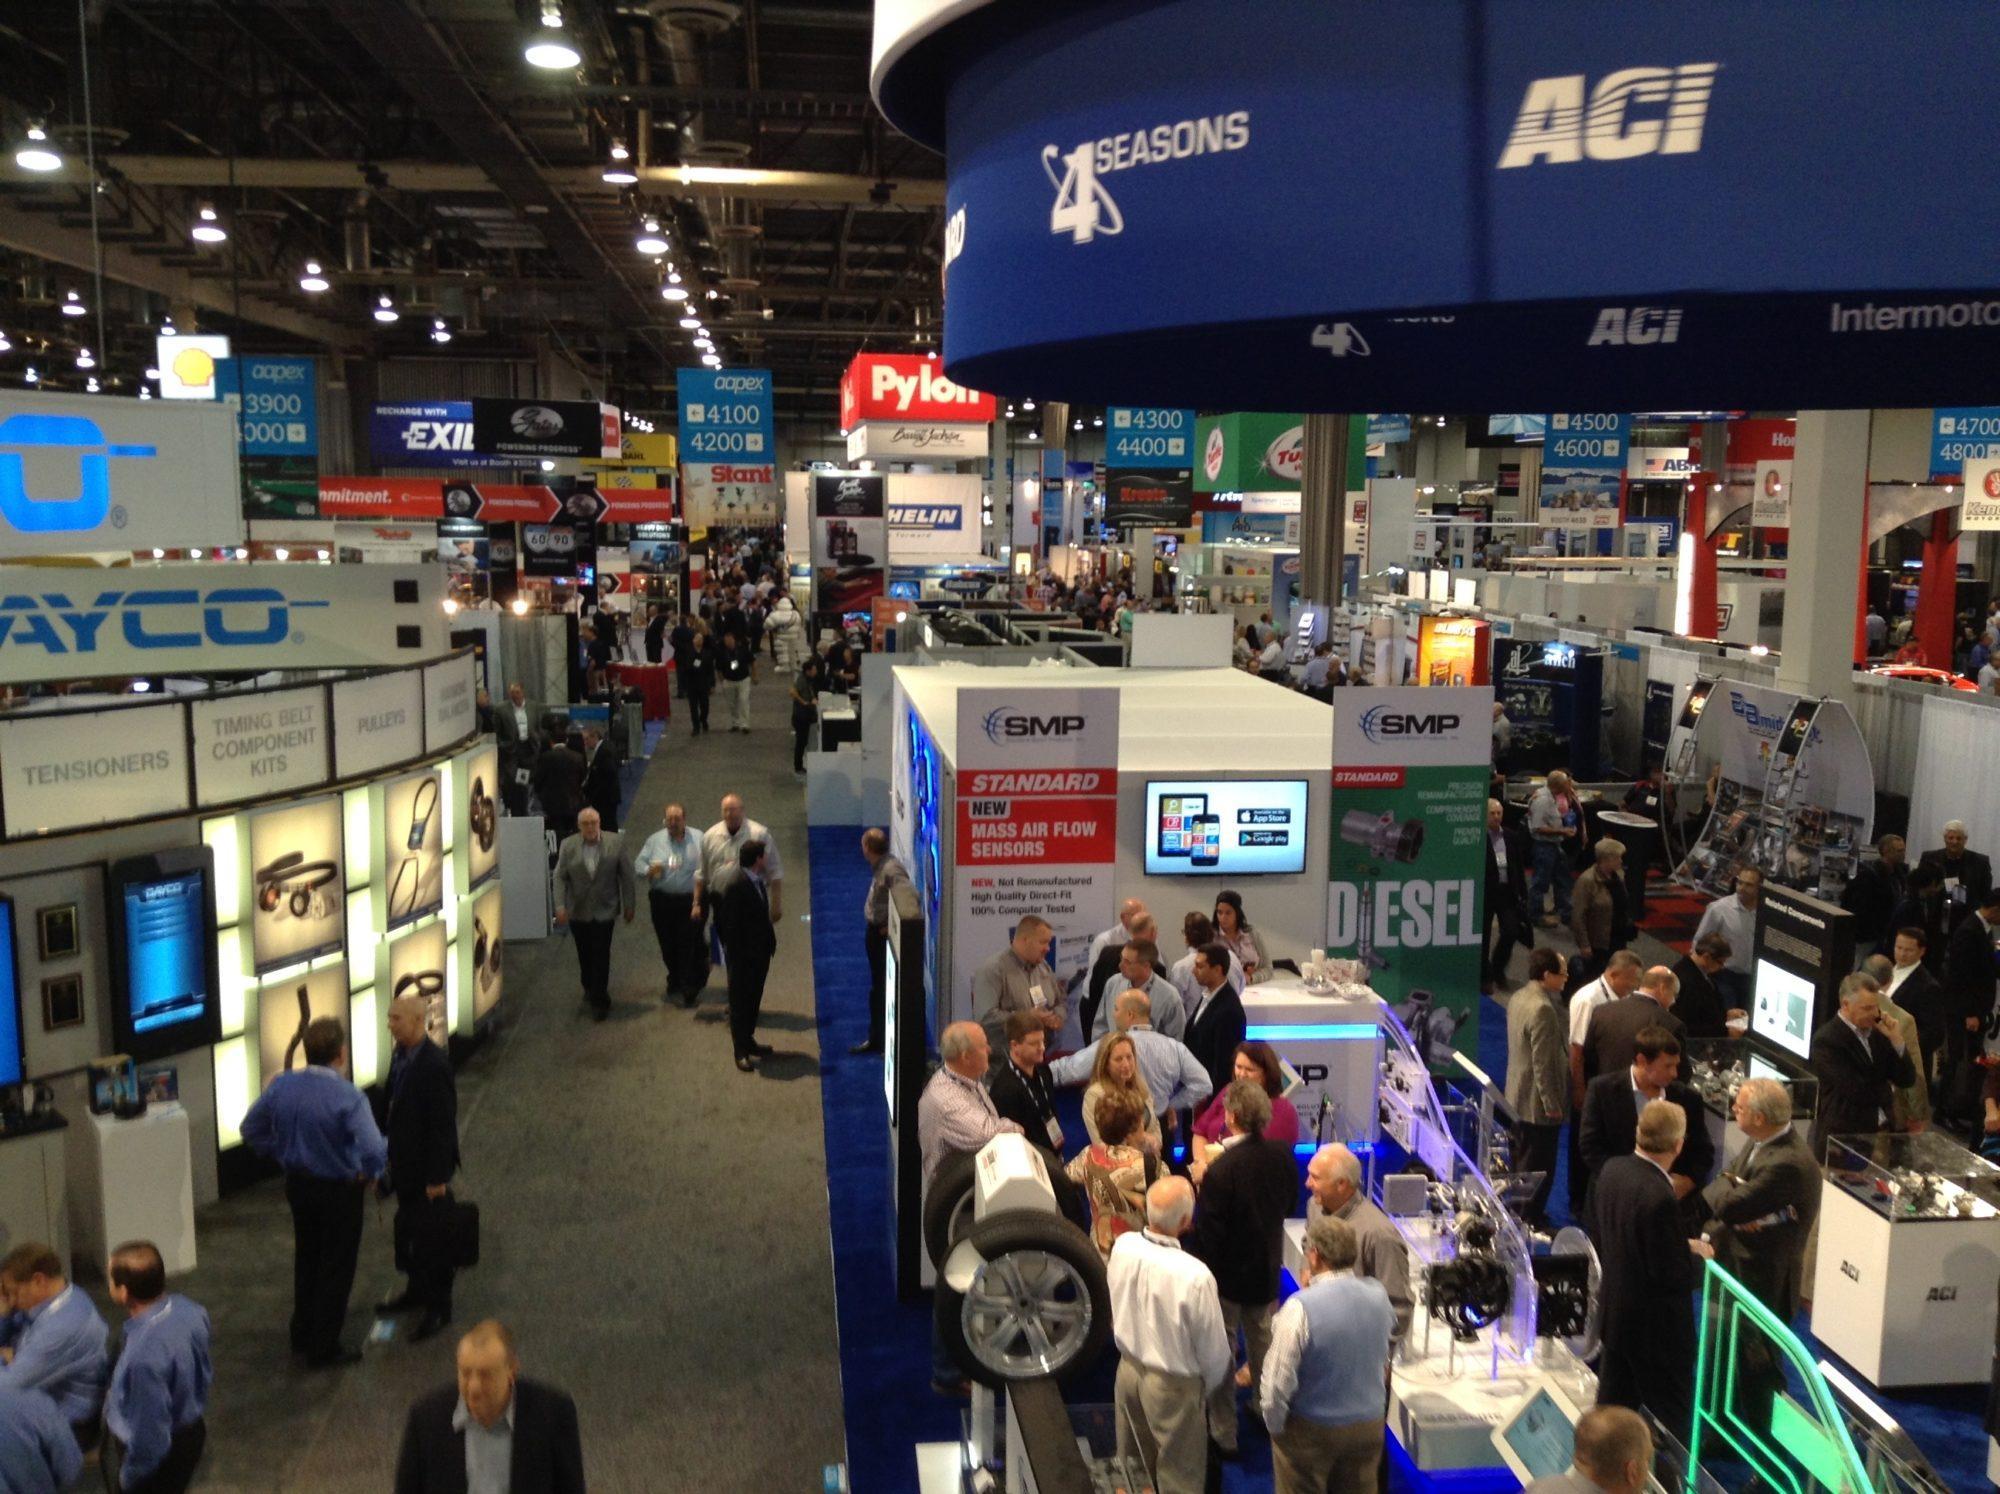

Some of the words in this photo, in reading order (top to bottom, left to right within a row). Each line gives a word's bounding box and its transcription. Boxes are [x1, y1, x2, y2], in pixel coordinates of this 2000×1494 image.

[1496, 62, 1720, 169] ACI
[1094, 110, 1250, 175] SEASONS
[1830, 301, 2000, 332] Intermoto
[1587, 307, 1684, 346] ACI
[252, 364, 305, 383] aapex
[714, 375, 764, 393] aapex
[246, 393, 302, 415] 3900
[376, 406, 422, 416] RECHARGE
[424, 407, 447, 417] WITH
[707, 404, 761, 425] 4100
[1133, 409, 1184, 430] 4300
[1570, 413, 1620, 431] 4500
[237, 422, 285, 444] 000
[1957, 418, 2000, 436] 4700
[691, 432, 744, 452] 4200
[1116, 437, 1167, 457] 4400
[1553, 439, 1602, 457] 4600
[1940, 443, 1986, 461] 4800
[711, 465, 773, 483] Stant
[530, 533, 545, 546] 60
[554, 534, 569, 546] 90
[212, 713, 273, 736] TIMING
[279, 705, 315, 727] BELT
[359, 709, 406, 736] PULLEYS
[1005, 716, 1085, 736] SMP
[1381, 714, 1460, 734] SMP
[211, 727, 317, 761] COMPONENT
[22, 750, 170, 786] TENSIONERS
[250, 755, 288, 777] KITS
[971, 773, 1100, 793] STANDARD
[1335, 772, 1399, 782] STANDARD
[972, 800, 1007, 816] NEW
[1253, 814, 1268, 823] App
[1269, 814, 1287, 823] Store
[971, 822, 1017, 839] MASS
[1021, 822, 1048, 838] AIR
[1053, 821, 1097, 837] FLOW
[1253, 834, 1274, 844] Google
[1275, 835, 1287, 844] play
[971, 841, 1045, 858] SENSORS
[998, 877, 1014, 887] Not
[1017, 876, 1093, 886] Remanufactured
[971, 891, 992, 903] High
[994, 890, 1027, 901] Quality
[1029, 890, 1072, 900] Direct-Fit
[971, 905, 996, 916] 100%
[998, 904, 1043, 916] Computer
[1045, 903, 1076, 913] Tested
[1840, 1258, 1860, 1283] ACI
[1927, 1286, 1958, 1302] ACI
